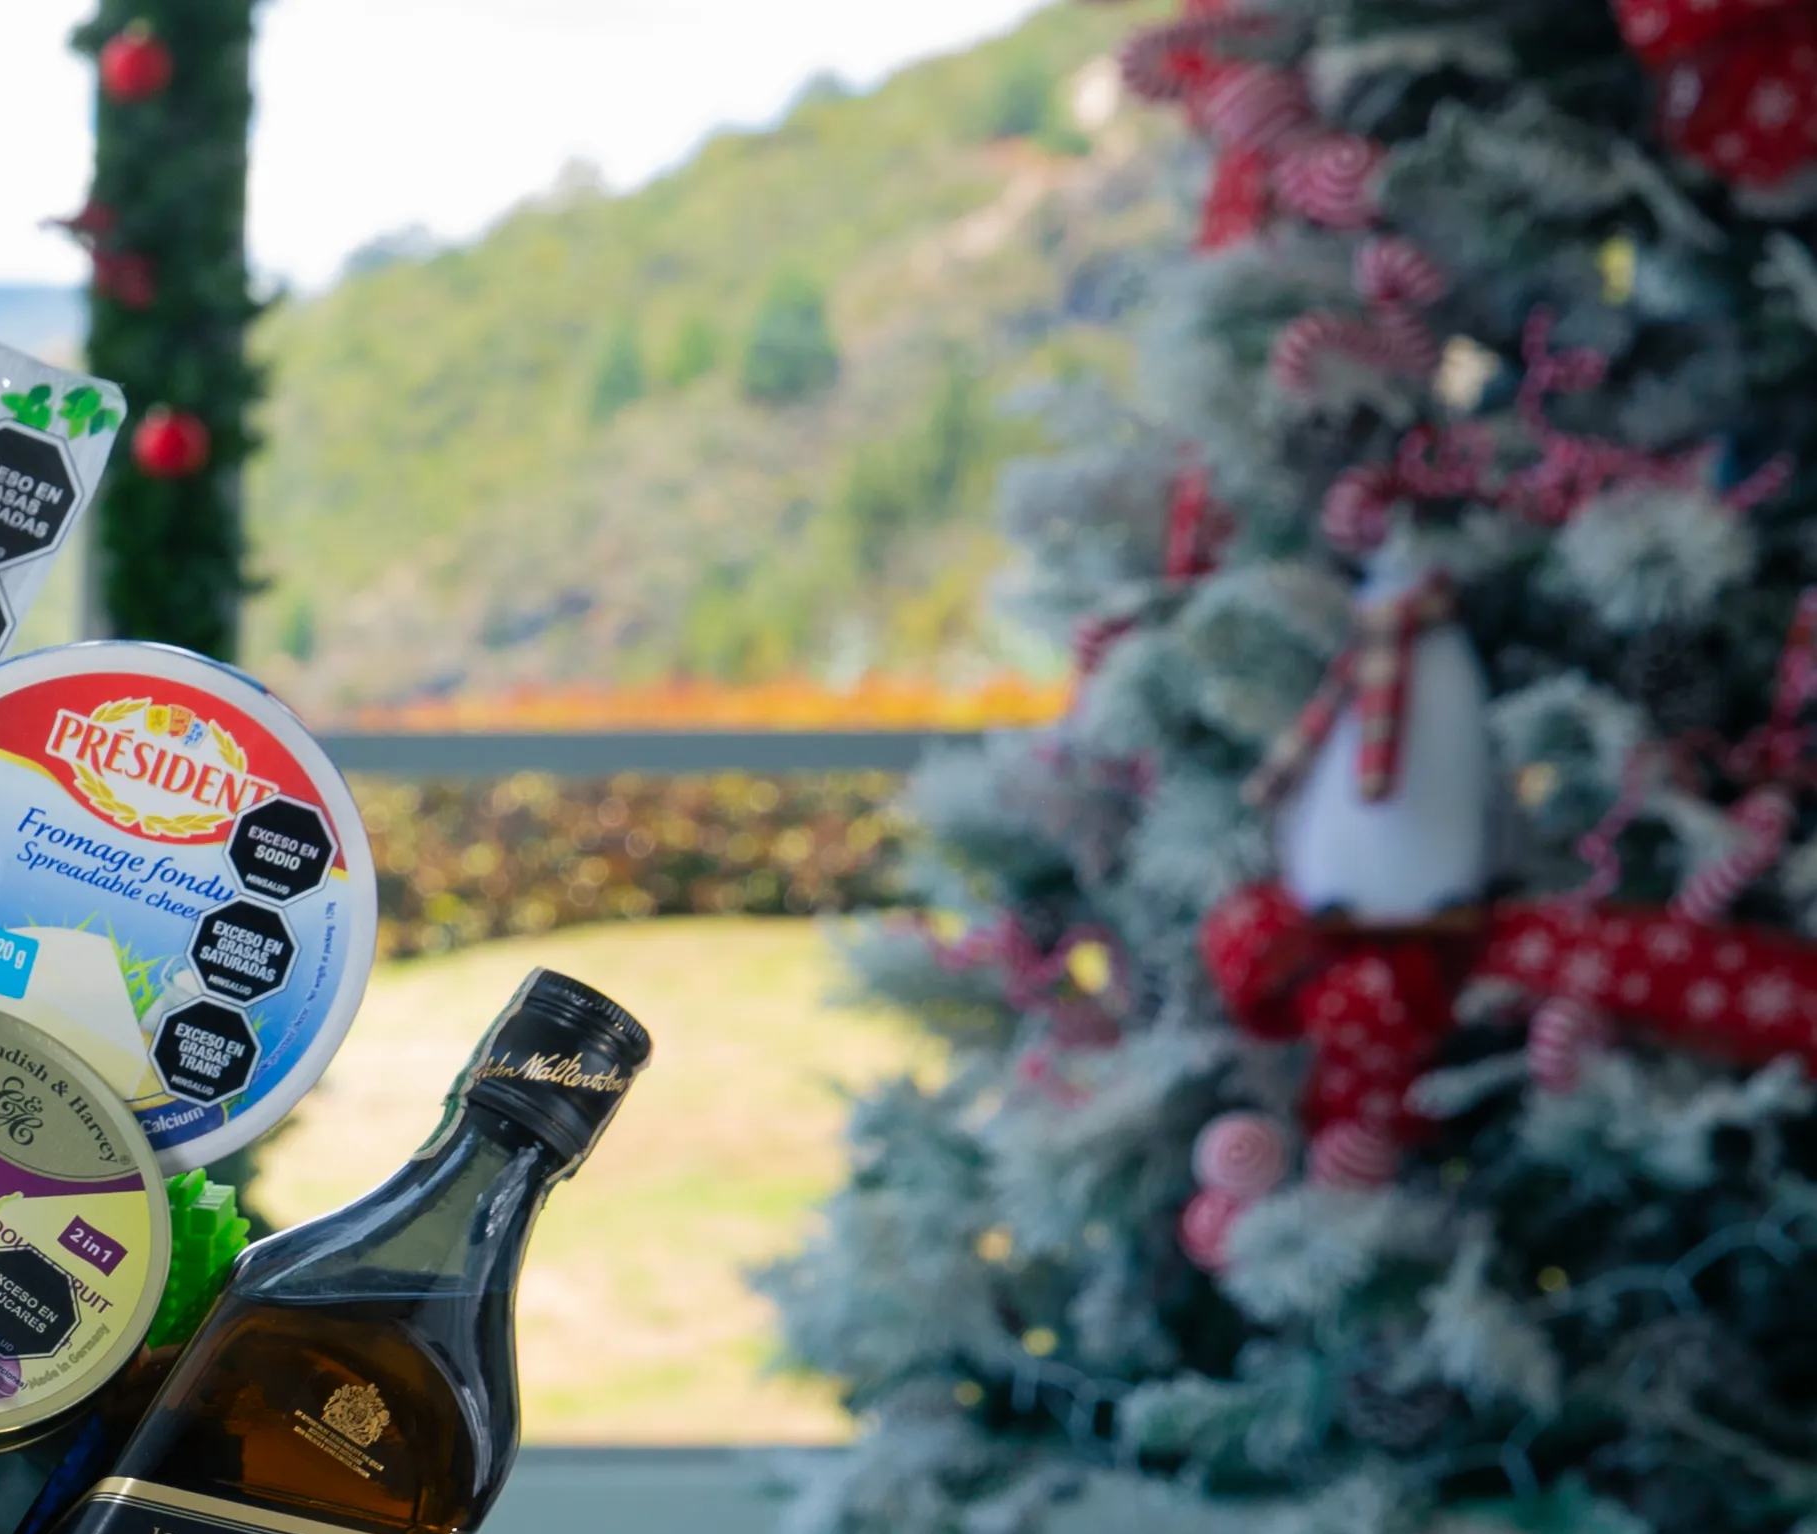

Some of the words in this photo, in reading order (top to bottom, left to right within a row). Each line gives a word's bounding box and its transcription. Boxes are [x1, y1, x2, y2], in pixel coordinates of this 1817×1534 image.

[36, 480, 64, 505] EN
[51, 712, 276, 813] PRÉSIDENT
[18, 807, 145, 873] Fromage
[138, 857, 235, 902] fondu
[248, 826, 302, 854] EXCESO
[302, 842, 320, 860] EN
[255, 843, 301, 871] SODIO
[213, 920, 265, 951] EXCESO
[266, 937, 284, 955] EN
[217, 939, 270, 966] GRASAS
[15, 948, 26, 969] g
[201, 947, 275, 982] SATURADAS
[174, 1022, 228, 1051] EXCESO
[227, 1040, 246, 1058] EN
[178, 1040, 232, 1068] GRASAS
[180, 1054, 222, 1079] TRANS
[51, 1077, 71, 1097] &
[70, 1093, 120, 1165] Harvey
[70, 1228, 82, 1243] 2
[82, 1236, 100, 1254] in
[102, 1250, 113, 1263] 1
[38, 1303, 59, 1323] EN
